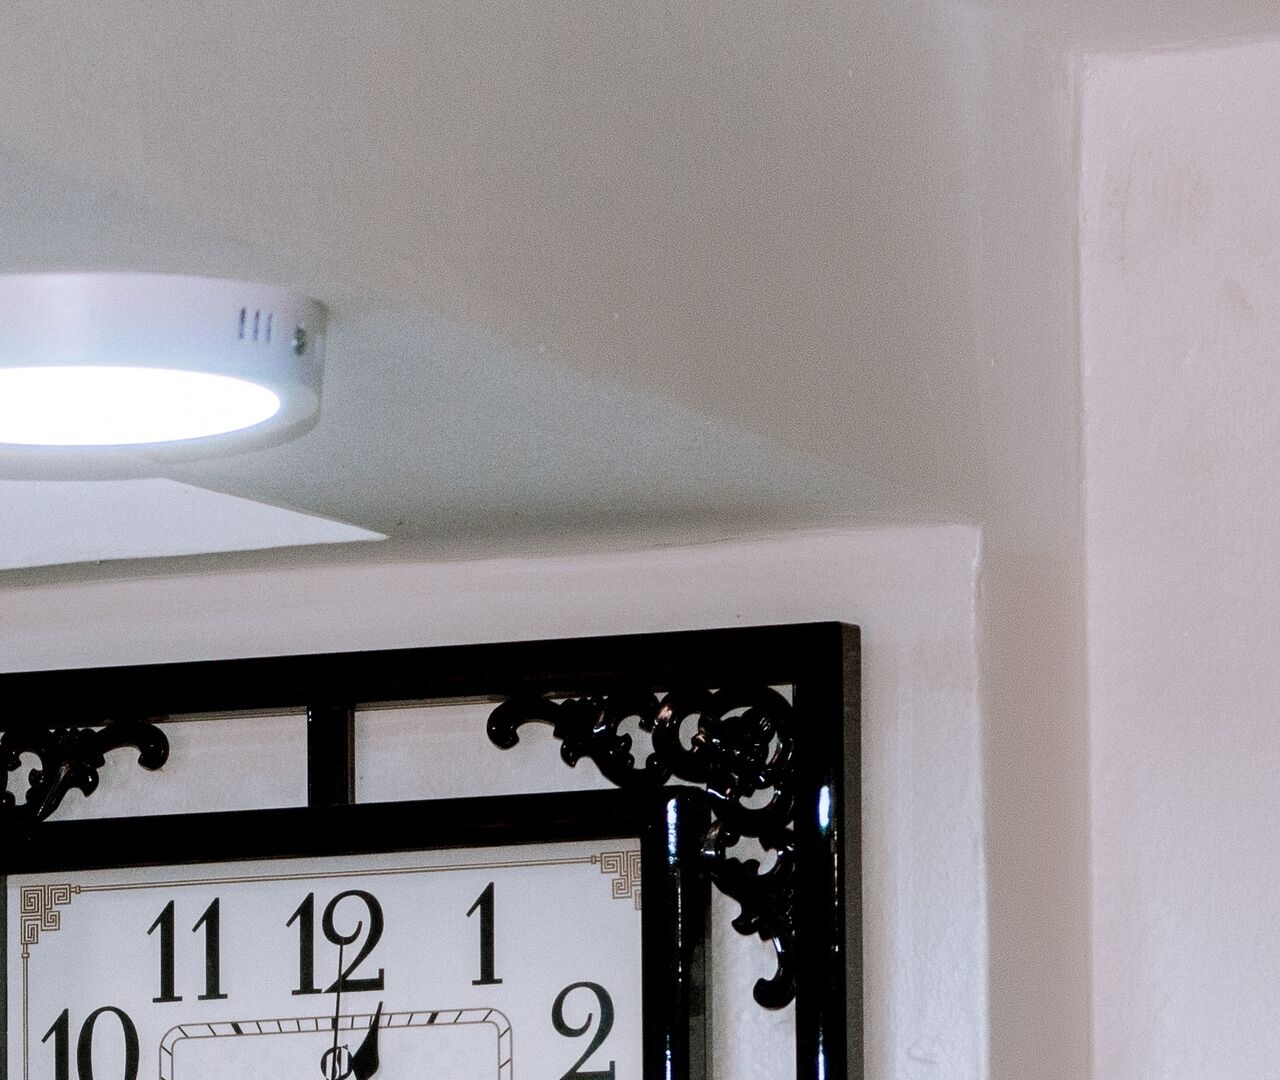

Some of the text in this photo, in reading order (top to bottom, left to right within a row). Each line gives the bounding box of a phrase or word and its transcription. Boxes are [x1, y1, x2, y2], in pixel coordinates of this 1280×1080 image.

[148, 898, 227, 1003] 11
[285, 889, 385, 996] 12
[467, 882, 502, 985] 1
